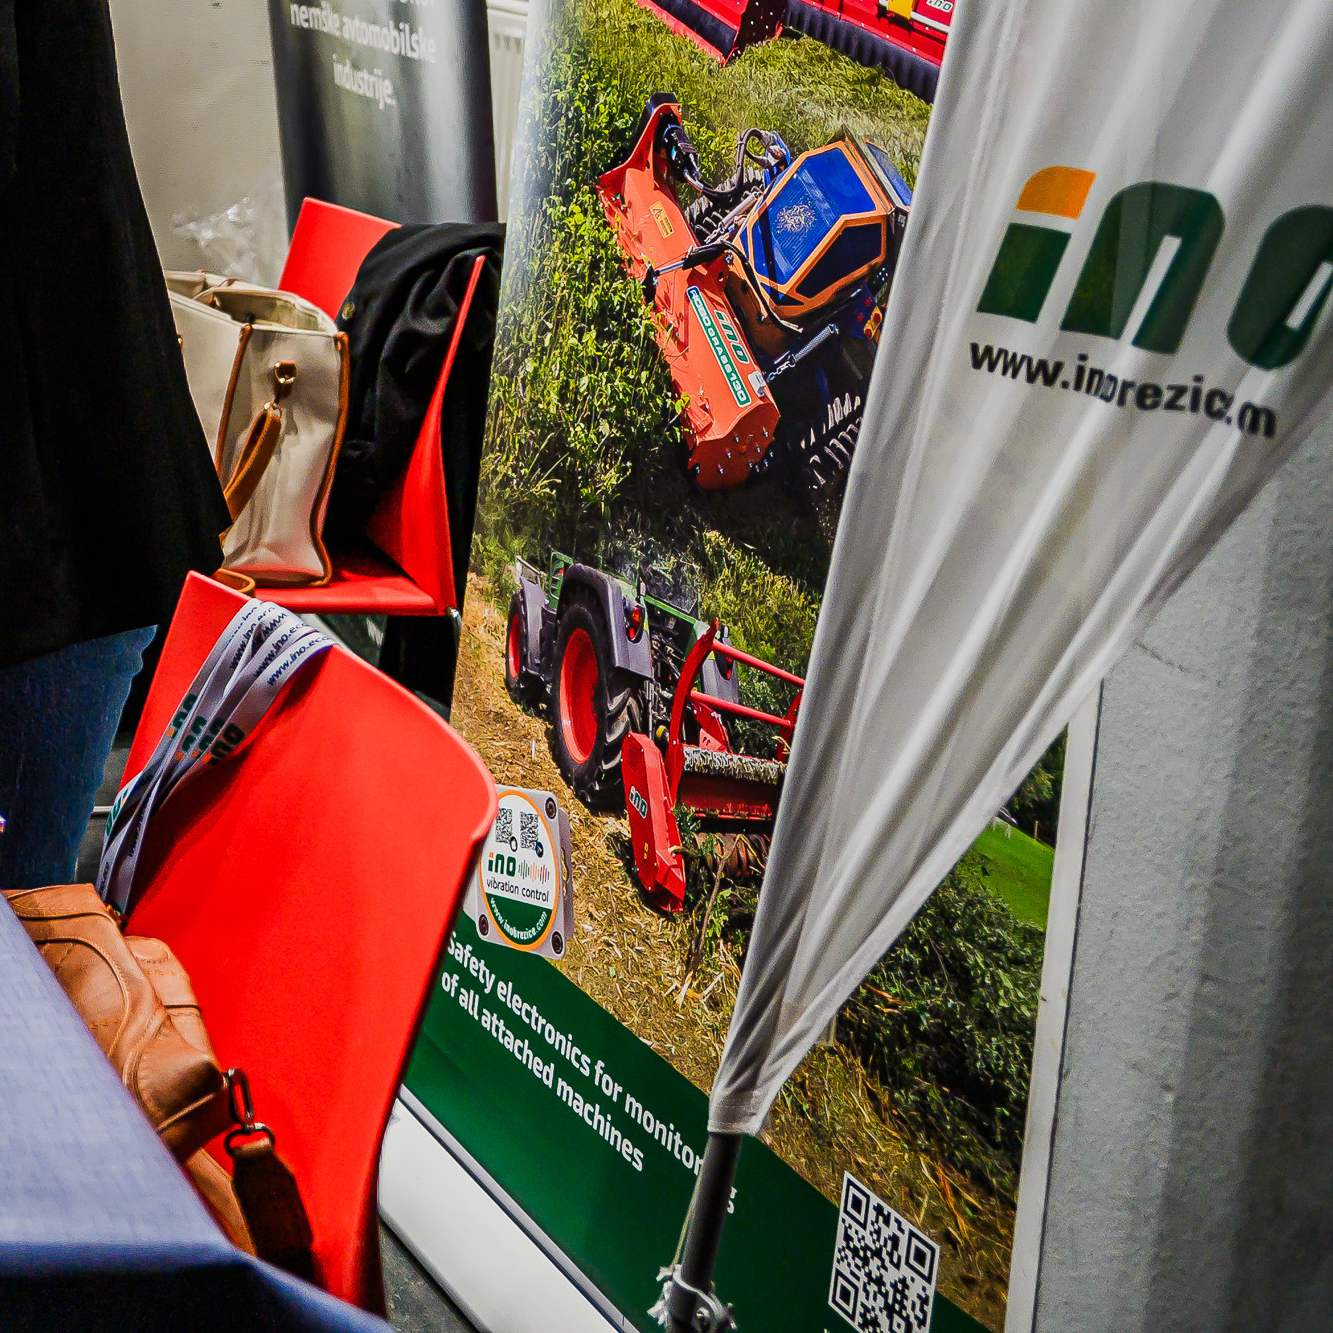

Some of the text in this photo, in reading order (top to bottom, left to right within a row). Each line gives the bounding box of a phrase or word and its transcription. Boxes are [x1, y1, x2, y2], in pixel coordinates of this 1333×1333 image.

[342, 14, 437, 64] avtomobilske
[201, 722, 245, 765] ino
[628, 785, 648, 820] ino
[488, 852, 517, 878] ino
[486, 877, 550, 903] vibration control
[497, 981, 591, 1077] electronics
[594, 1060, 624, 1103] for
[441, 971, 645, 1172] of all attached machines
